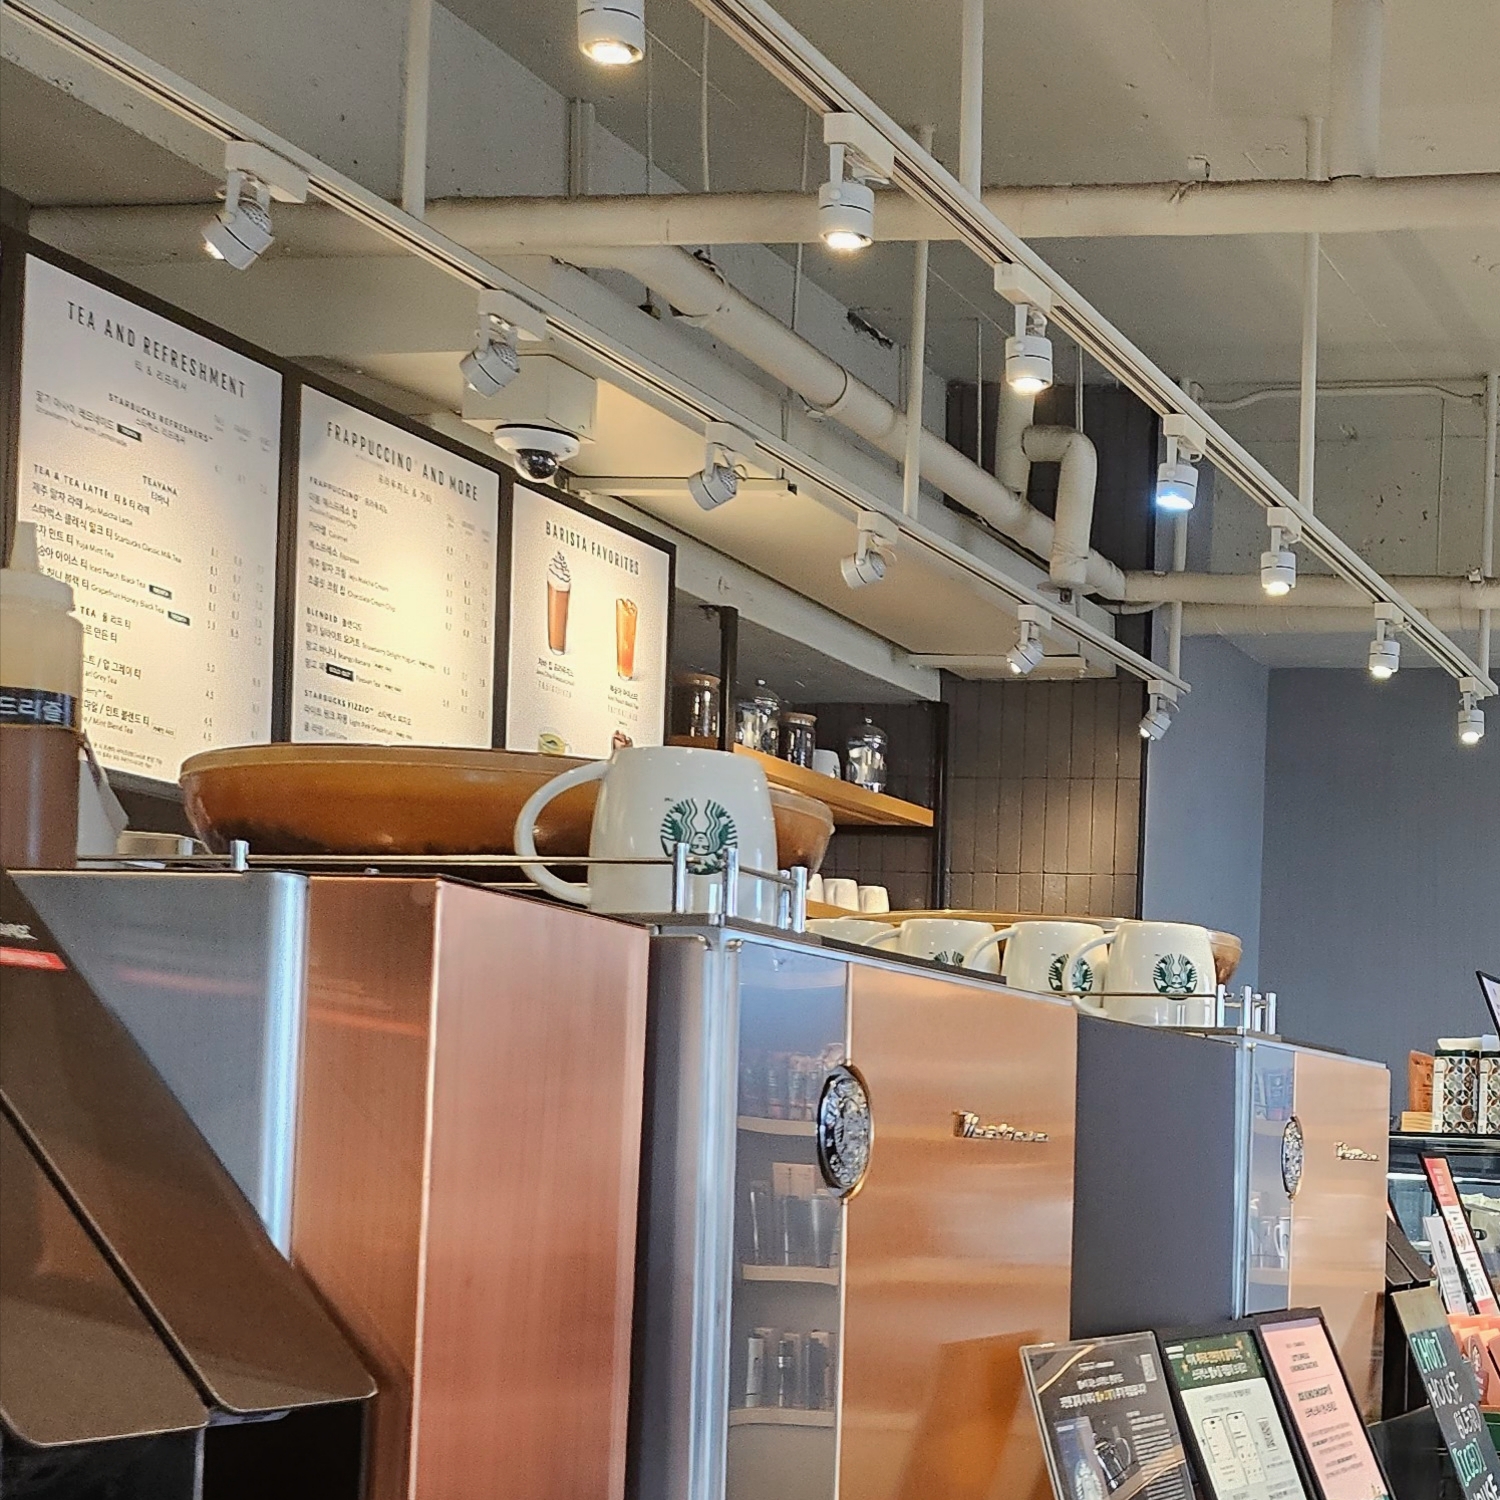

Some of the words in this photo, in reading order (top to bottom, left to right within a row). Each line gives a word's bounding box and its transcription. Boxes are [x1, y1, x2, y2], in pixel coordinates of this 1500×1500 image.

[67, 300, 96, 331] TEA
[104, 319, 135, 348] AND
[143, 336, 246, 399] REFRESHMENT
[108, 393, 157, 420] STARBUCKS
[32, 481, 48, 497] 제주
[33, 464, 50, 477] TEA
[63, 475, 80, 489] TEA
[83, 481, 109, 500] LATTE
[142, 475, 178, 496] TEAVANA
[422, 463, 445, 486] AND
[449, 474, 479, 501] MORE
[31, 502, 63, 522] 스타벅스
[105, 526, 113, 541] 티
[36, 523, 47, 537] 자
[48, 526, 65, 542] 민트
[66, 532, 74, 546] 티
[38, 545, 54, 559] 숭아
[55, 550, 79, 568] 아이스
[80, 558, 88, 571] 티
[545, 520, 588, 553] BARISTA
[591, 541, 640, 576] FAVORITES
[81, 578, 90, 591] 티
[80, 605, 96, 618] TEA
[124, 618, 131, 629] 티
[307, 606, 338, 623] BLENDED
[110, 632, 118, 643] 티
[112, 662, 133, 677] 그레이
[134, 667, 142, 679] 티
[304, 689, 346, 708] STARBUCKS
[143, 715, 150, 726] 티
[1428, 1372, 1463, 1408] HOUSE
